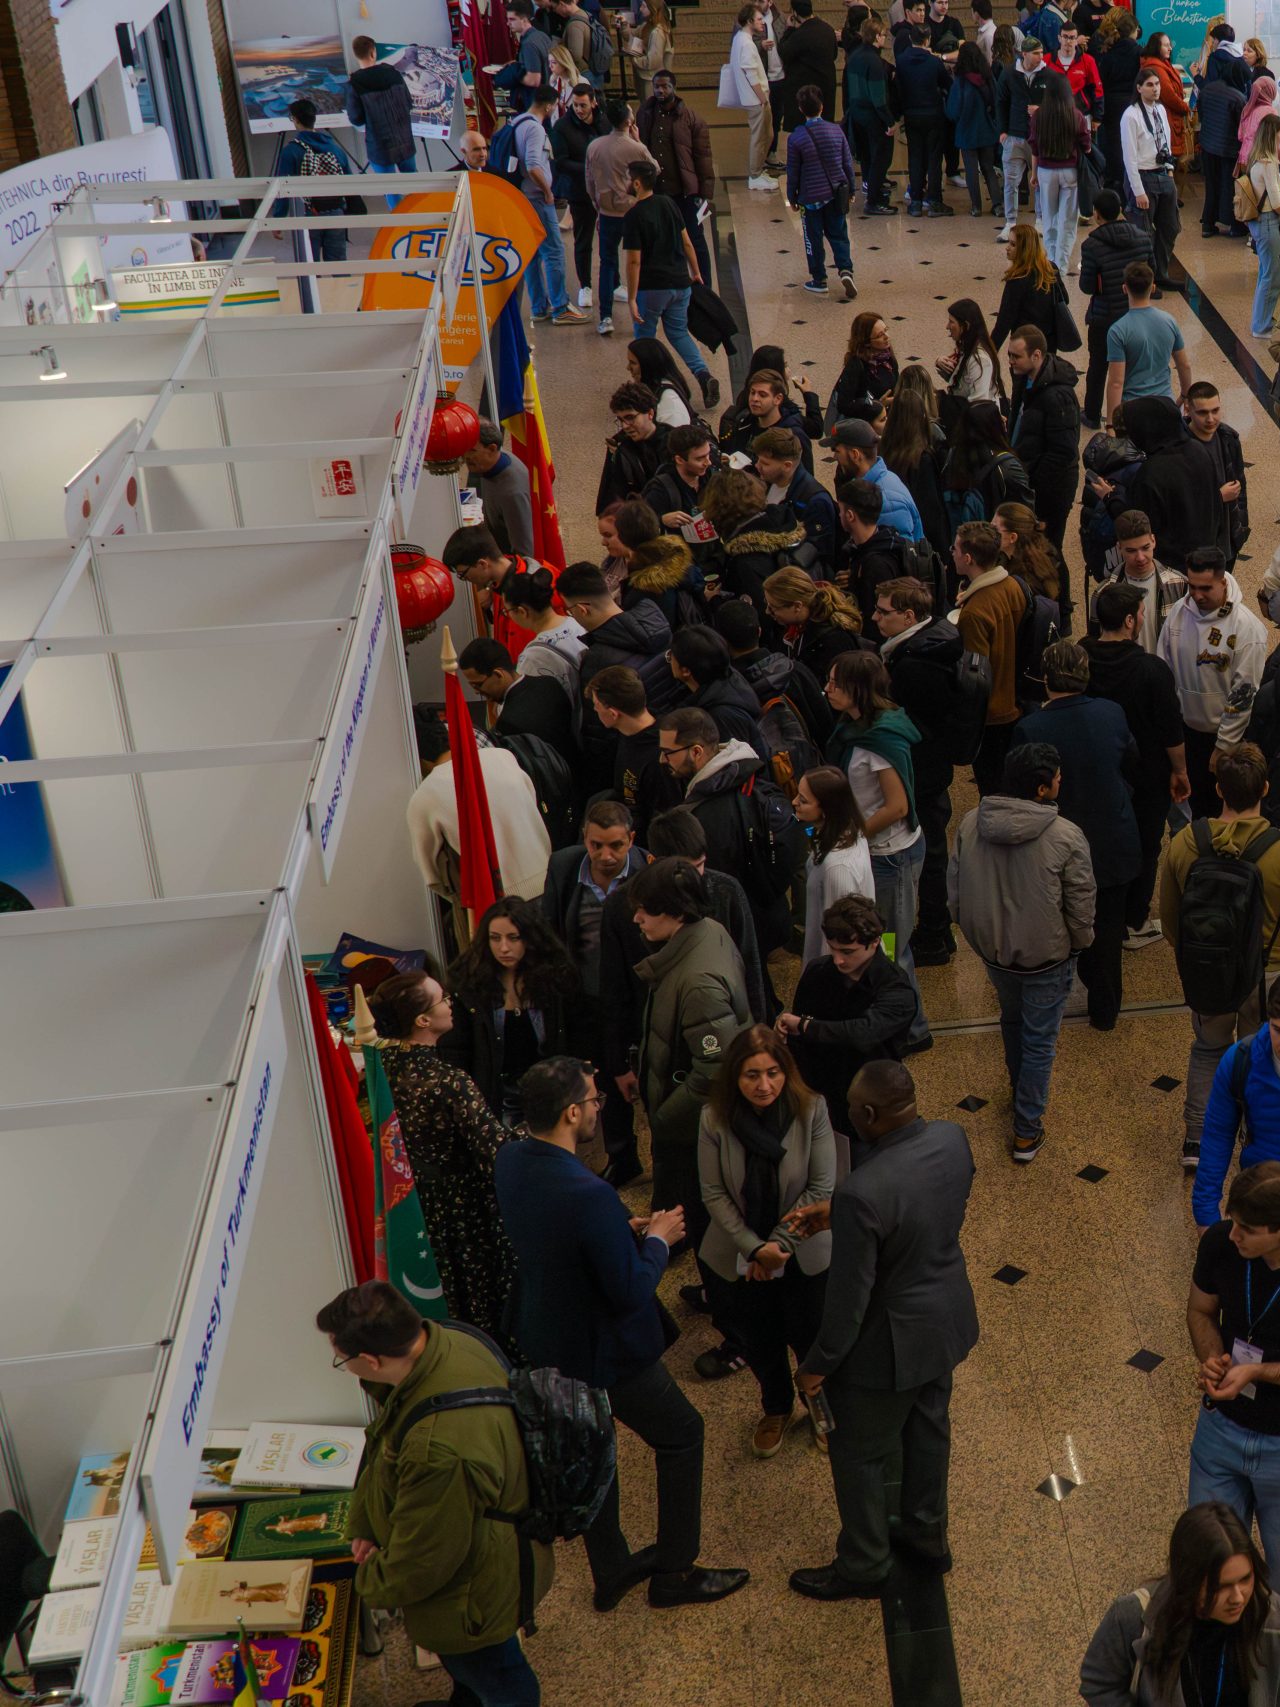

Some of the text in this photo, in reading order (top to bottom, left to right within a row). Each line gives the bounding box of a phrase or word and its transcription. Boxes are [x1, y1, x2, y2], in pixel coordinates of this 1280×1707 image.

[0, 179, 51, 214] TEHNICA
[53, 174, 73, 192] din
[5, 211, 41, 246] 2022
[124, 270, 188, 284] FACULTATEA
[192, 269, 205, 278] DE
[165, 281, 195, 292] LIMBI
[335, 463, 352, 494] 平安
[321, 773, 342, 851] Embassy
[182, 1061, 272, 1447] Embassy of Turkmenistan
[179, 1643, 205, 1699] Turkmenistan
